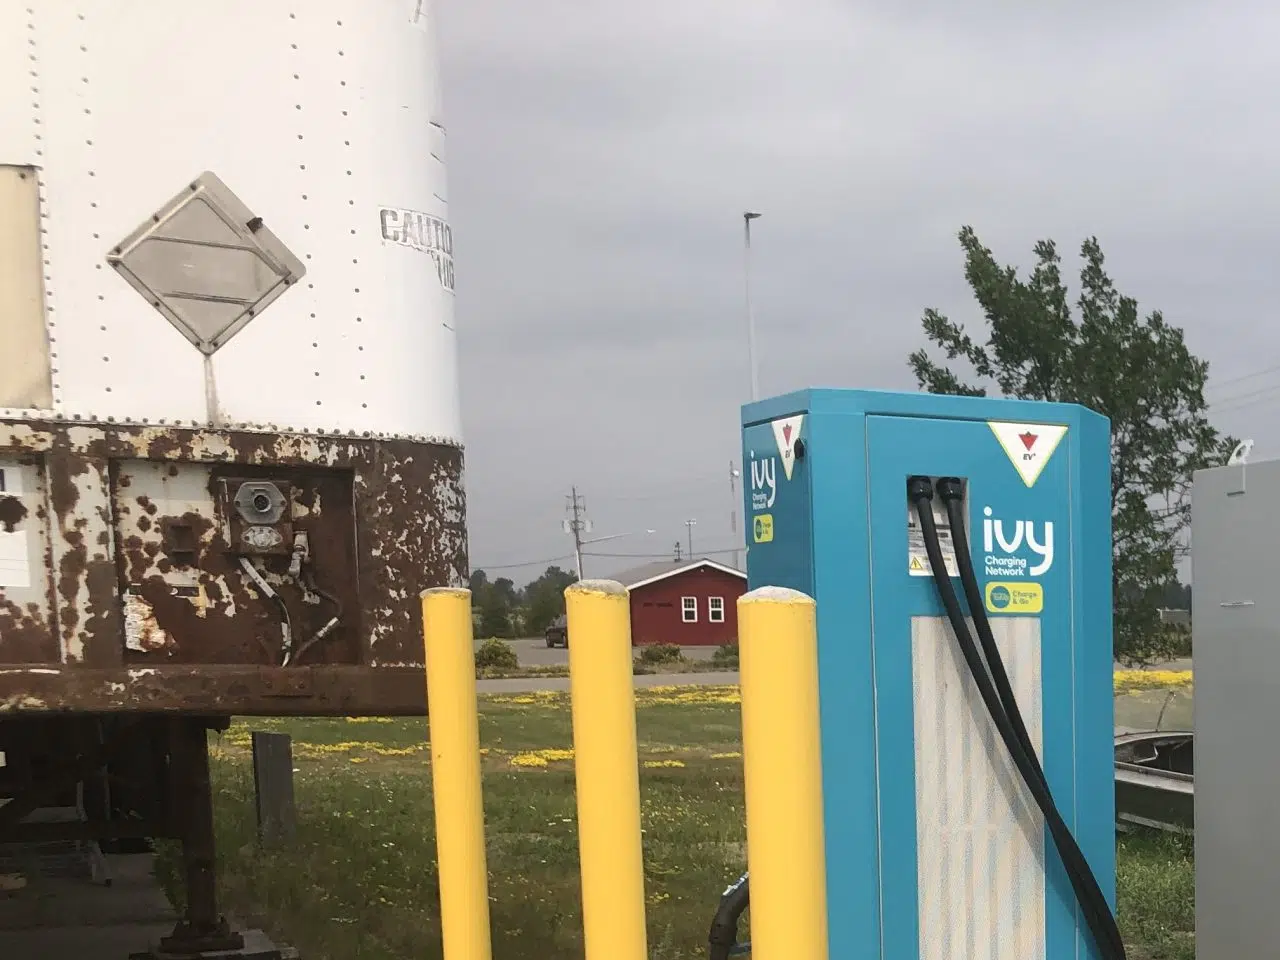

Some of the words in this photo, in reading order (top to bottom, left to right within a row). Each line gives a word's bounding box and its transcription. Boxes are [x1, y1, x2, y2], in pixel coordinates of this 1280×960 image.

[751, 449, 776, 508] ivy
[983, 506, 1054, 577] ivy
[984, 555, 1027, 568] Charging
[984, 566, 1025, 576] Network
